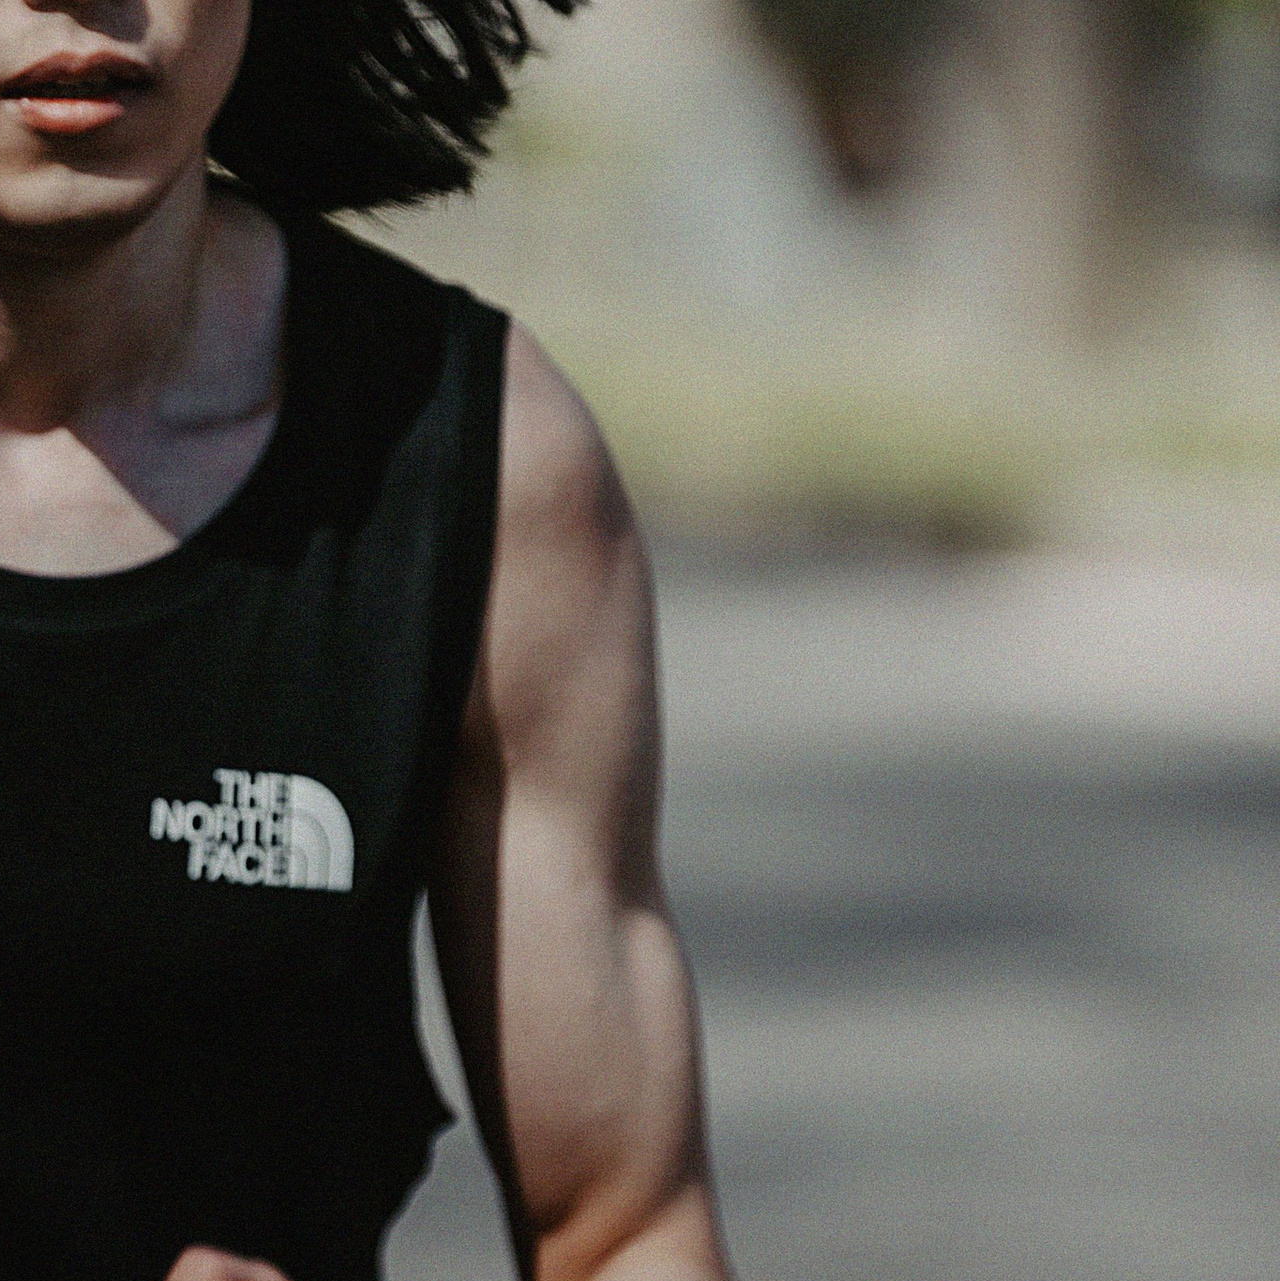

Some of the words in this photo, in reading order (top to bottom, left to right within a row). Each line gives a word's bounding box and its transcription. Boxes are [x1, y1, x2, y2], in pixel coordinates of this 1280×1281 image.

[213, 768, 288, 808] THE
[149, 797, 288, 846] NORTH
[186, 840, 288, 887] FACE
